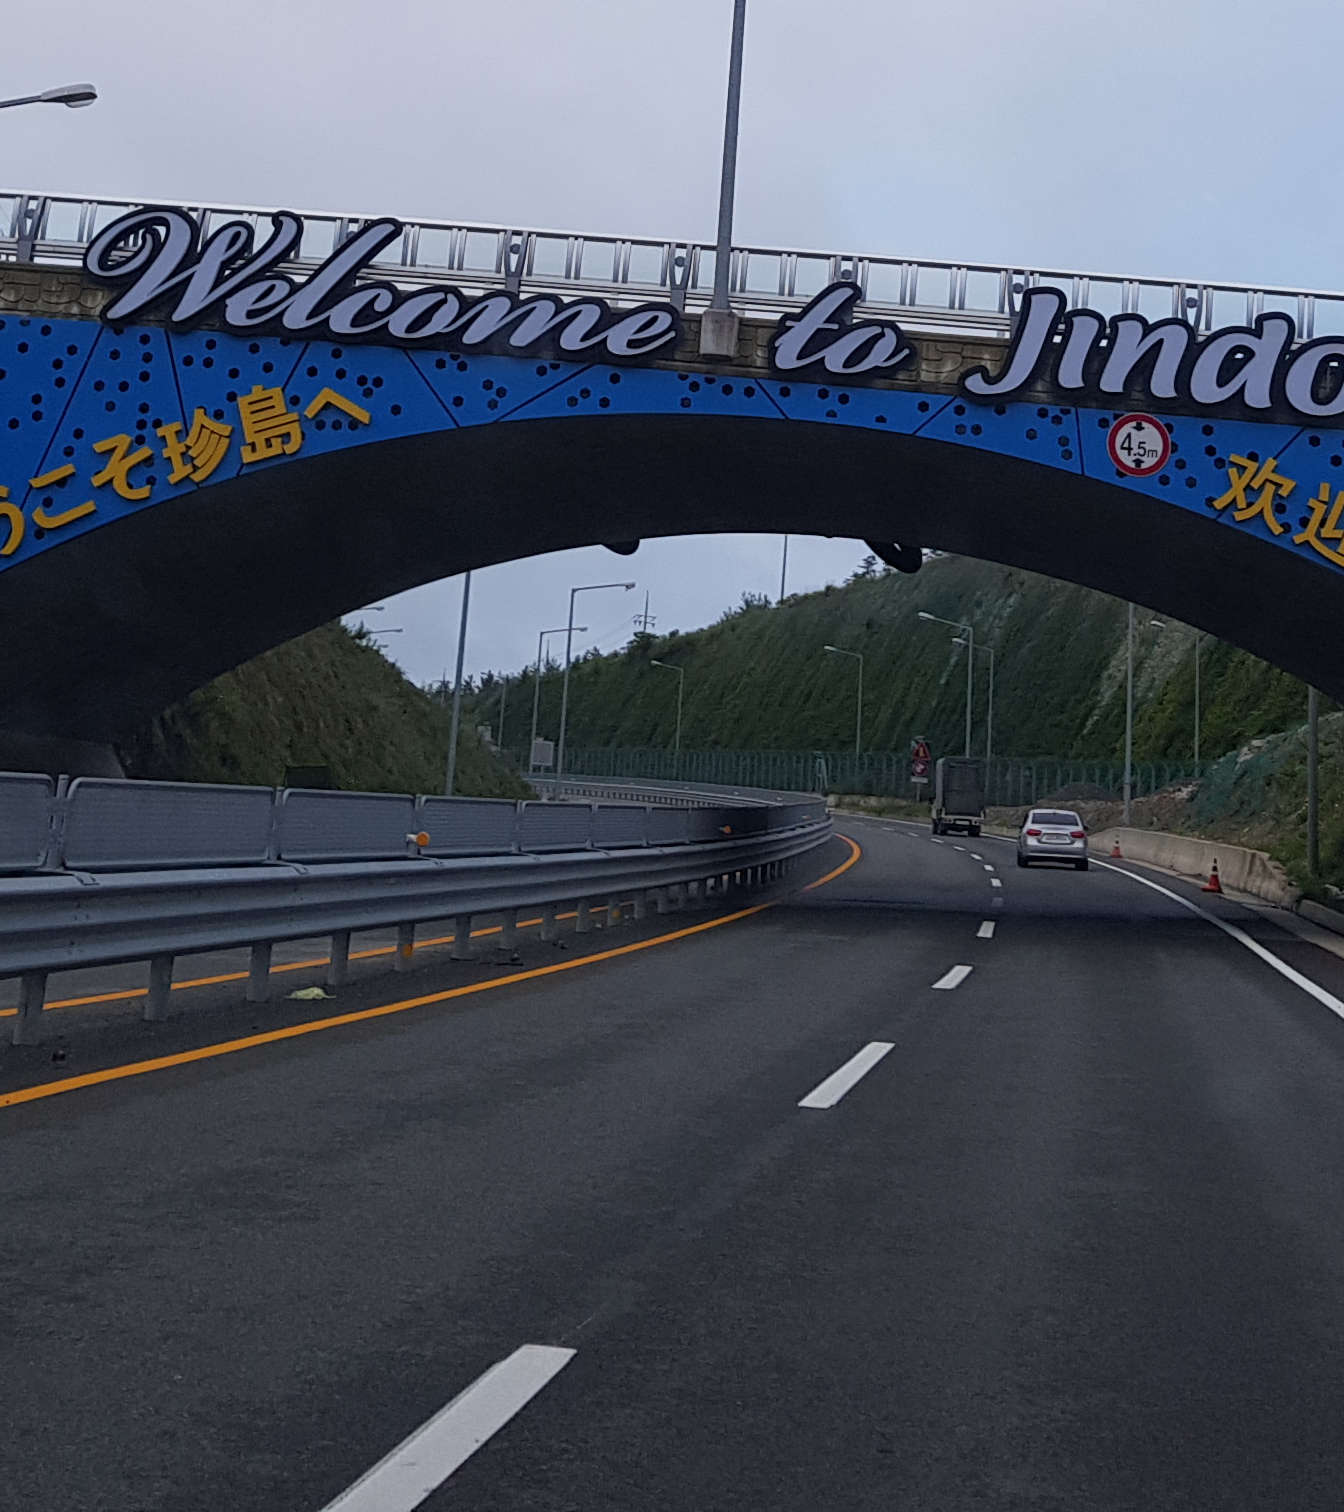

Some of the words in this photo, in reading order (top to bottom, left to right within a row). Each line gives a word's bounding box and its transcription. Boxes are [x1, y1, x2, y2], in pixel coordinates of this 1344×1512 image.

[84, 208, 679, 359] Welcome
[771, 285, 911, 377] to
[1120, 431, 1158, 459] 4.5m
